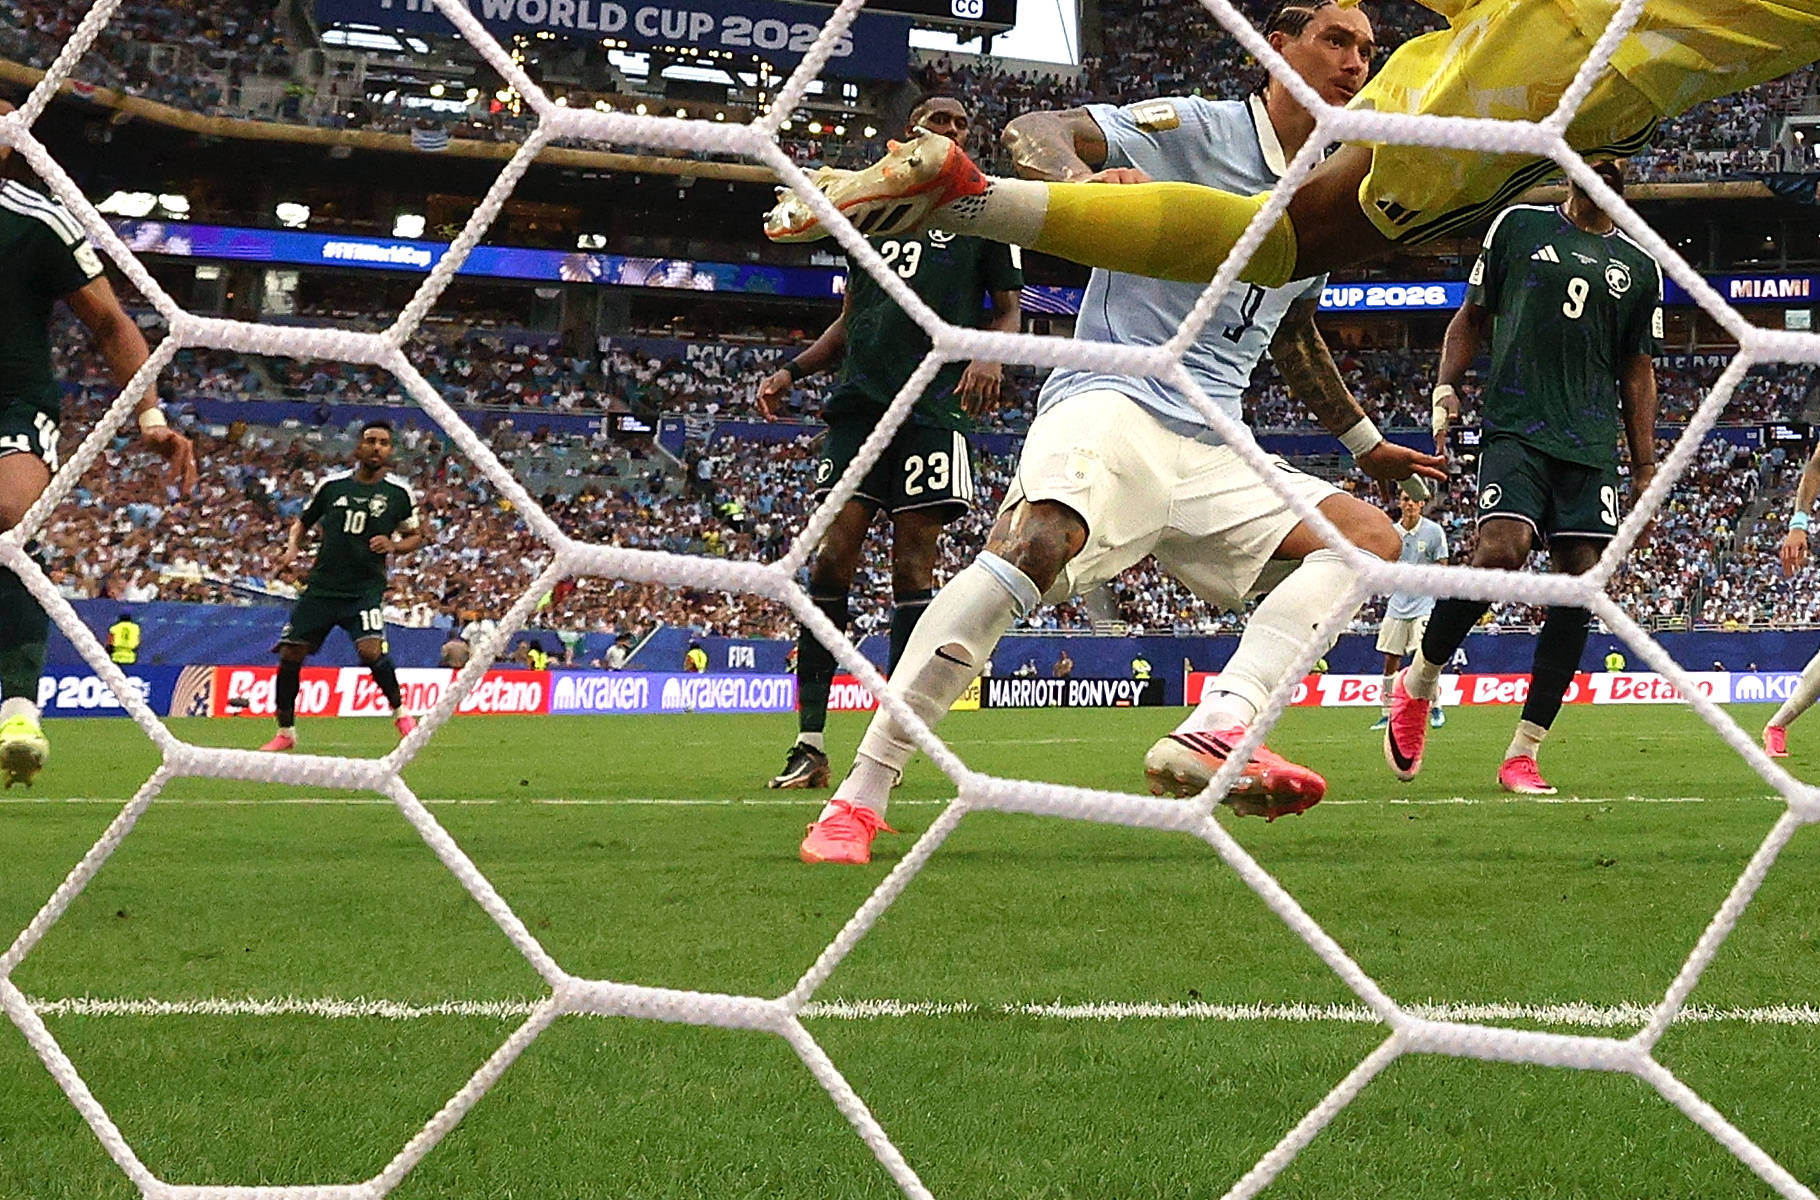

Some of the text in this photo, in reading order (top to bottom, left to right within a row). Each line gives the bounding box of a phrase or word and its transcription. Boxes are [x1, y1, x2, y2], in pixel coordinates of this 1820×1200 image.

[635, 6, 713, 42] CUP
[881, 240, 922, 279] 23
[1320, 286, 1446, 307] CUP 2026
[1563, 277, 1590, 319] 9
[1730, 278, 1811, 299] MIAMI
[1222, 283, 1266, 344] 9
[905, 451, 950, 496] 23
[343, 509, 368, 535] 10
[360, 608, 384, 631] 10
[729, 646, 755, 668] FIFA
[577, 676, 647, 710] kraken
[681, 677, 791, 710] kraken.com
[827, 684, 873, 710] enovo
[989, 680, 1065, 708] MARRIOTT
